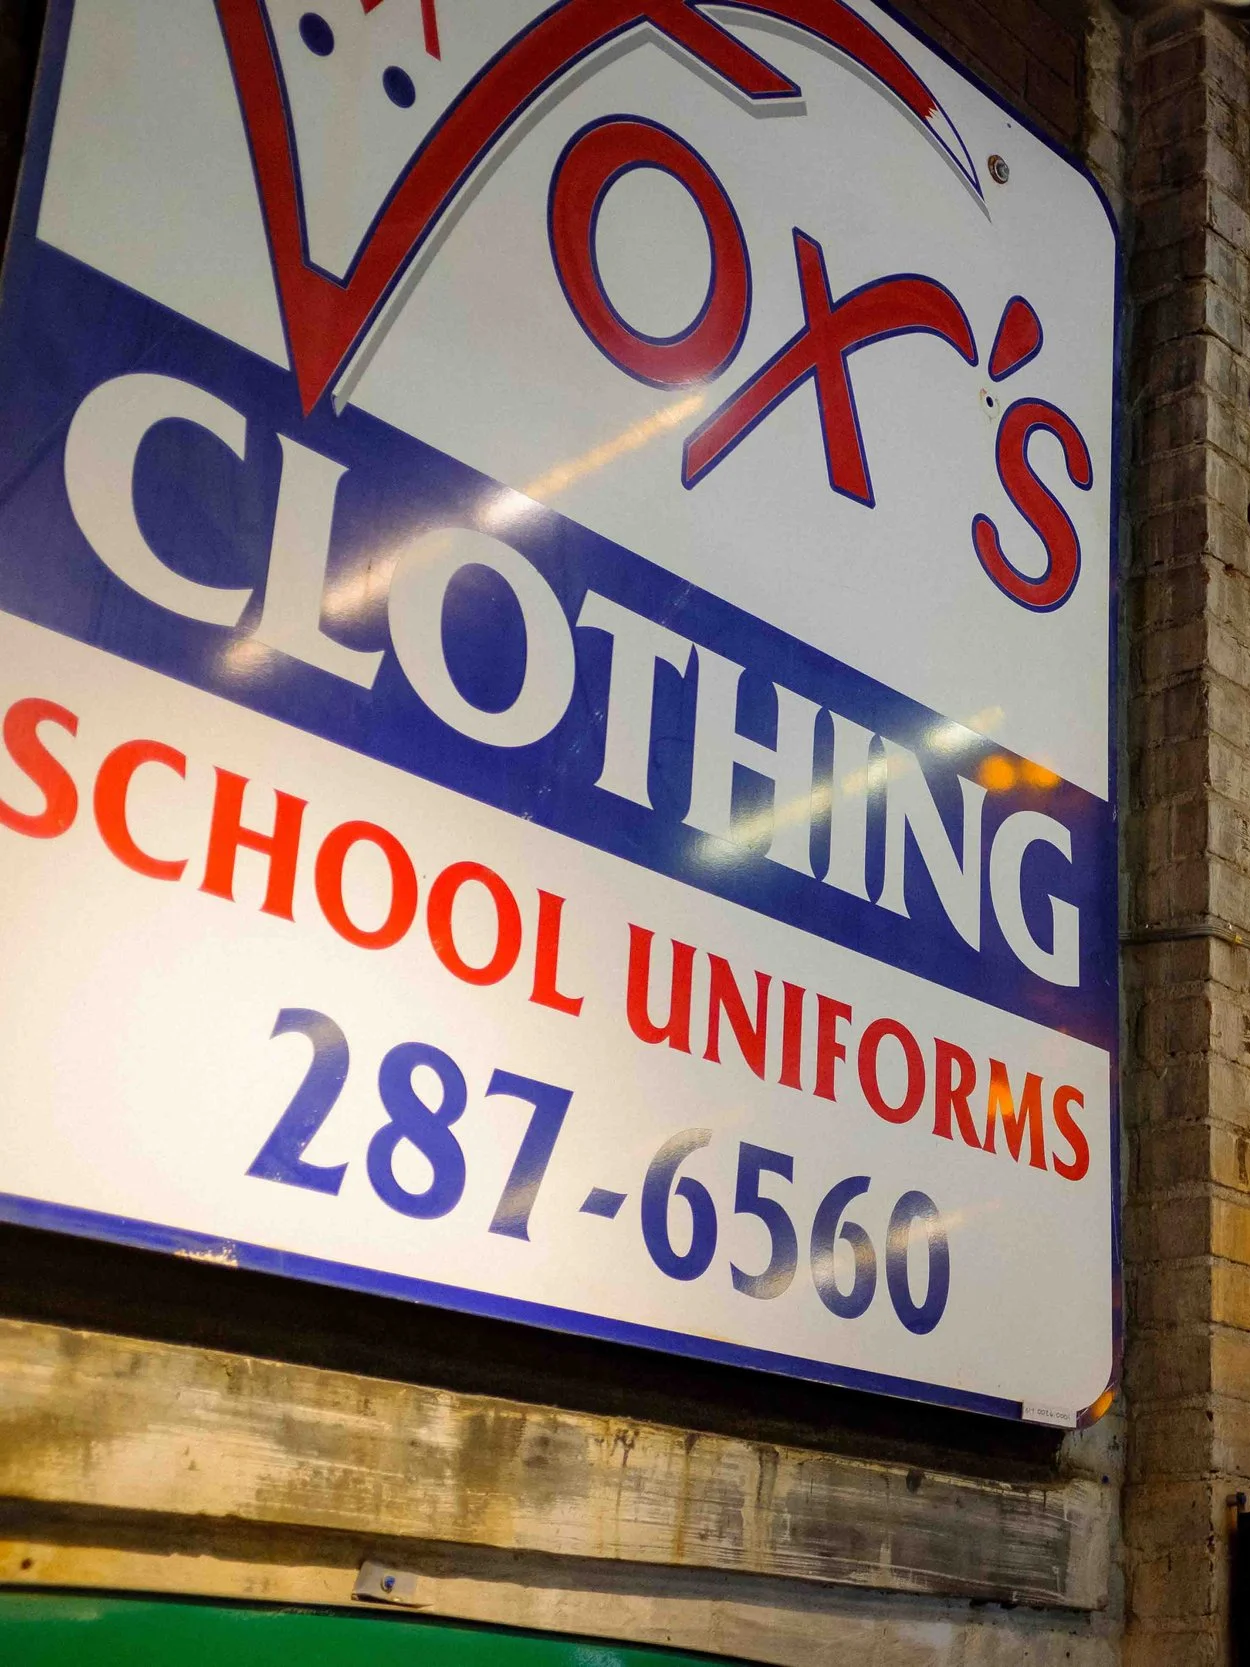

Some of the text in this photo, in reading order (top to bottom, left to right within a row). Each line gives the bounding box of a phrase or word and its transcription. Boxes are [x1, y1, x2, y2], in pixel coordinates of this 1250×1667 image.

[64, 373, 1080, 987] CLOTHING
[0, 697, 1090, 1182] SCHOOL UNIFORMS
[245, 1007, 951, 1336] 287-6560
